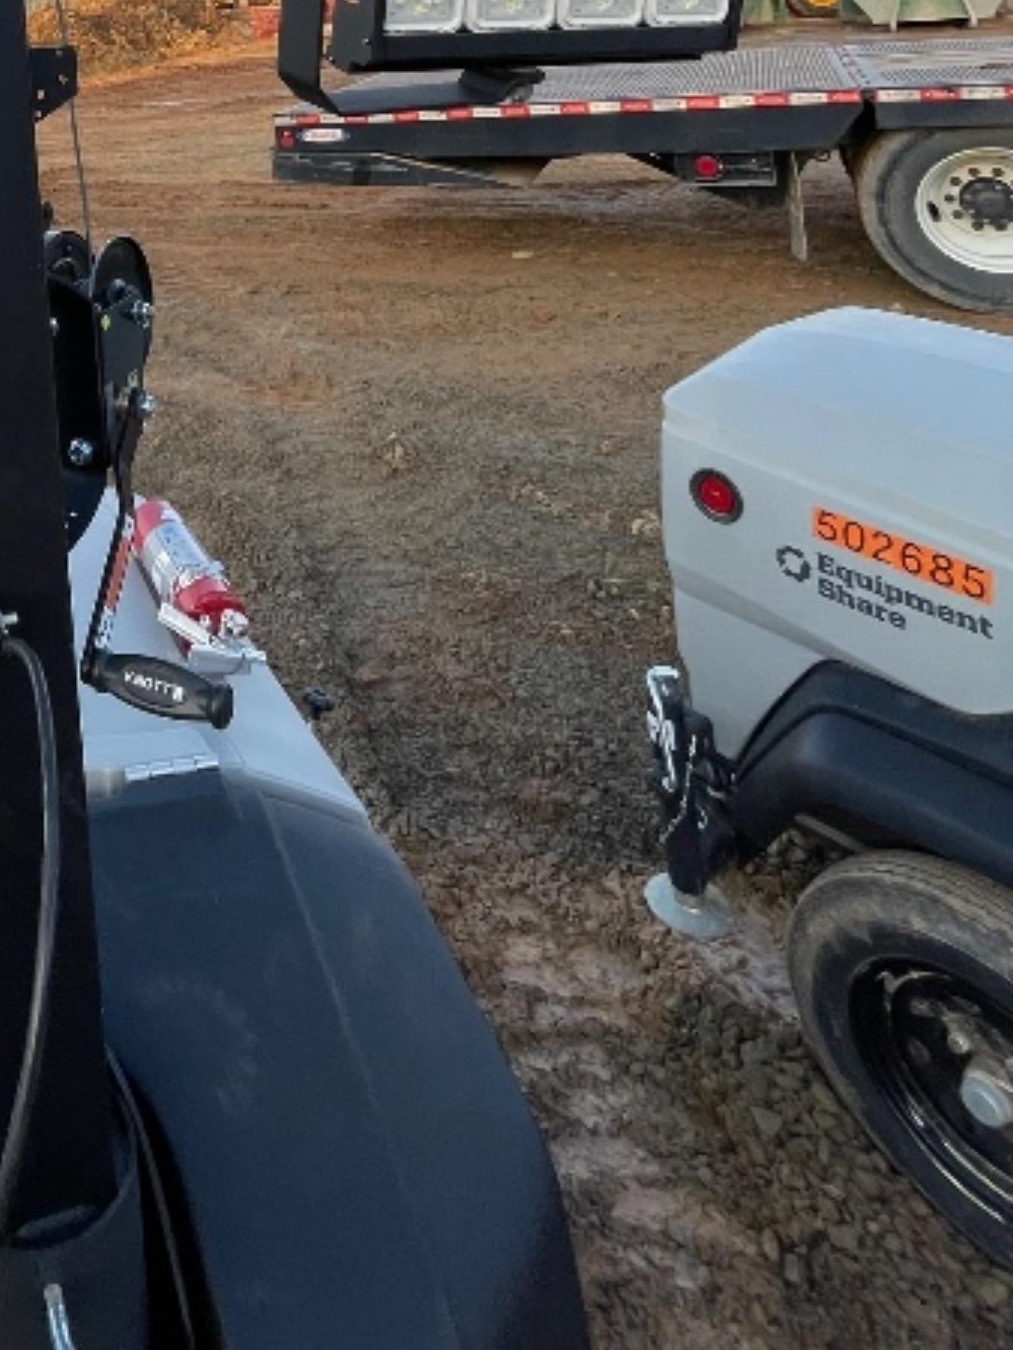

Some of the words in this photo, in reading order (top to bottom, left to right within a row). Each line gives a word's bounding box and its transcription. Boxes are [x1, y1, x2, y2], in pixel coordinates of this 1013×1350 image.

[817, 509, 986, 599] 502685
[817, 552, 994, 639] Equipment
[817, 577, 907, 630] Share
